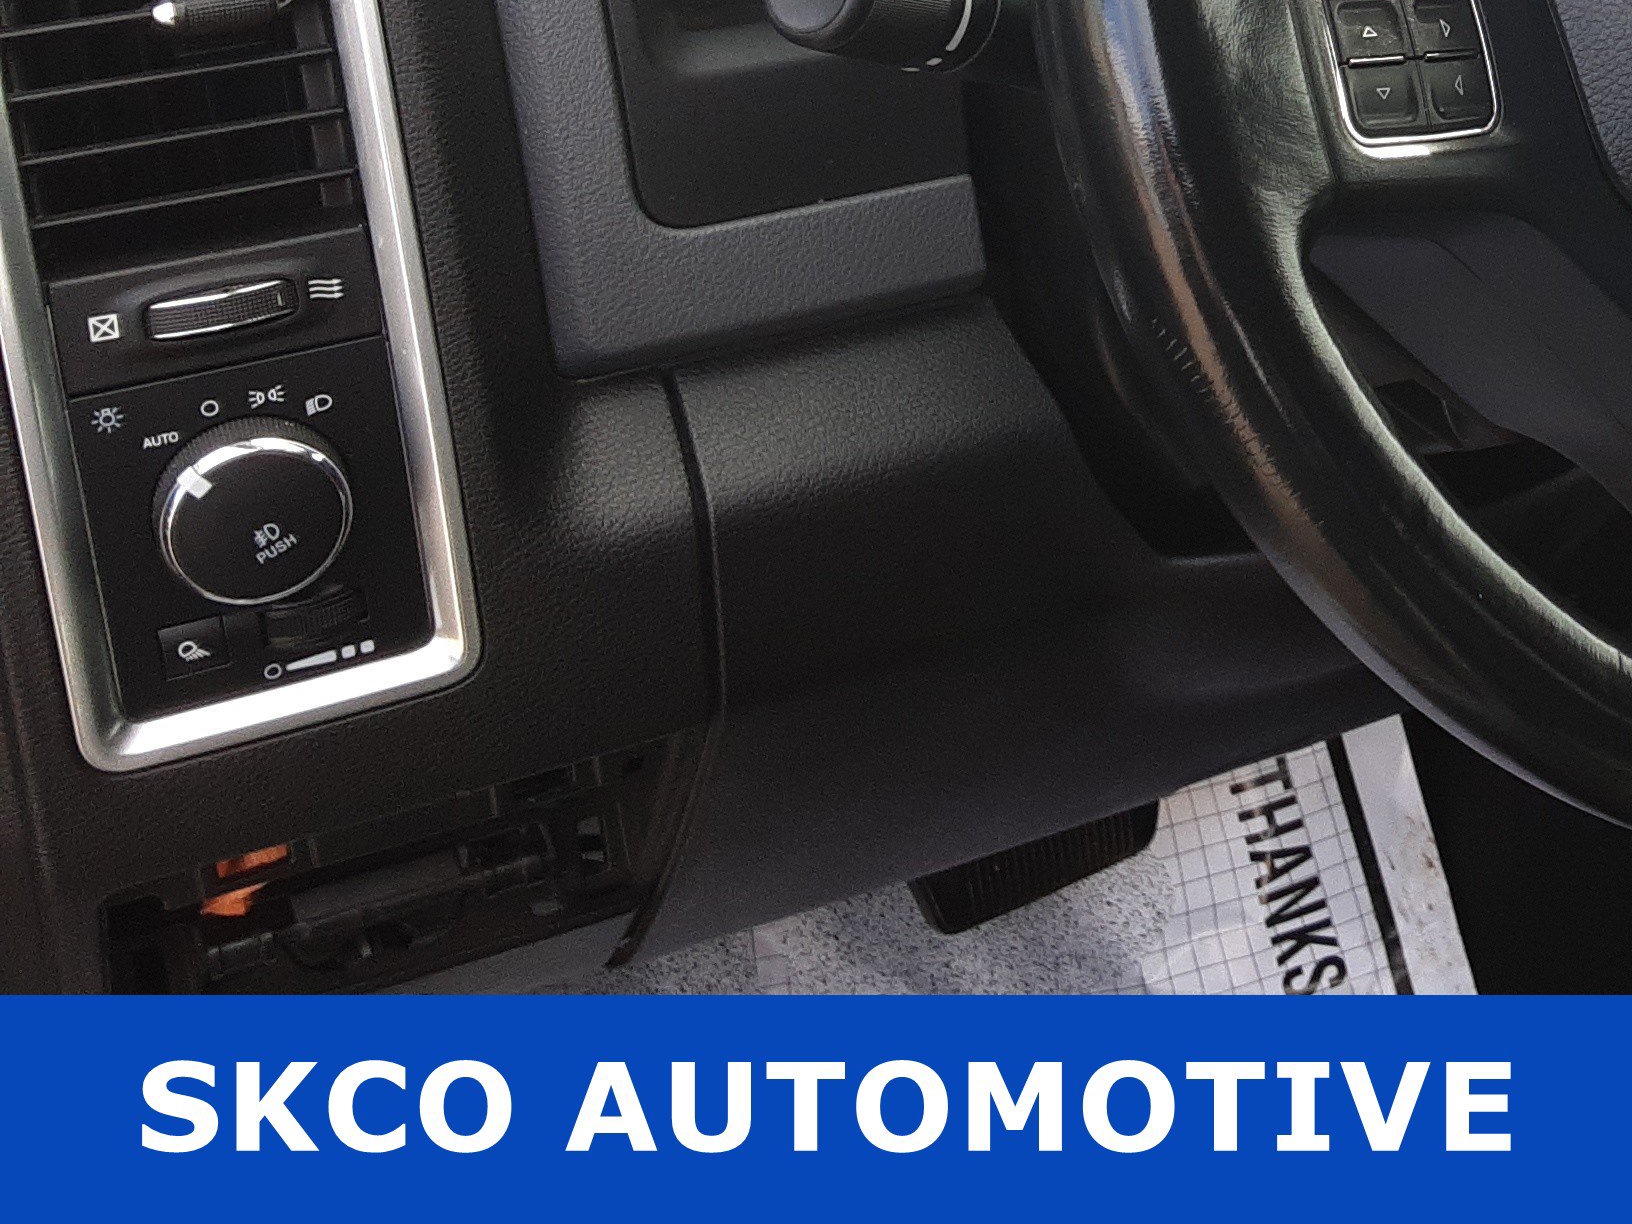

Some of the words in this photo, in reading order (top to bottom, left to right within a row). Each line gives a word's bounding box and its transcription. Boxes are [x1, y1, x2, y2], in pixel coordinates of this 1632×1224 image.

[142, 431, 179, 450] AUTO
[255, 533, 298, 565] PUSH
[1229, 757, 1347, 996] THANKS
